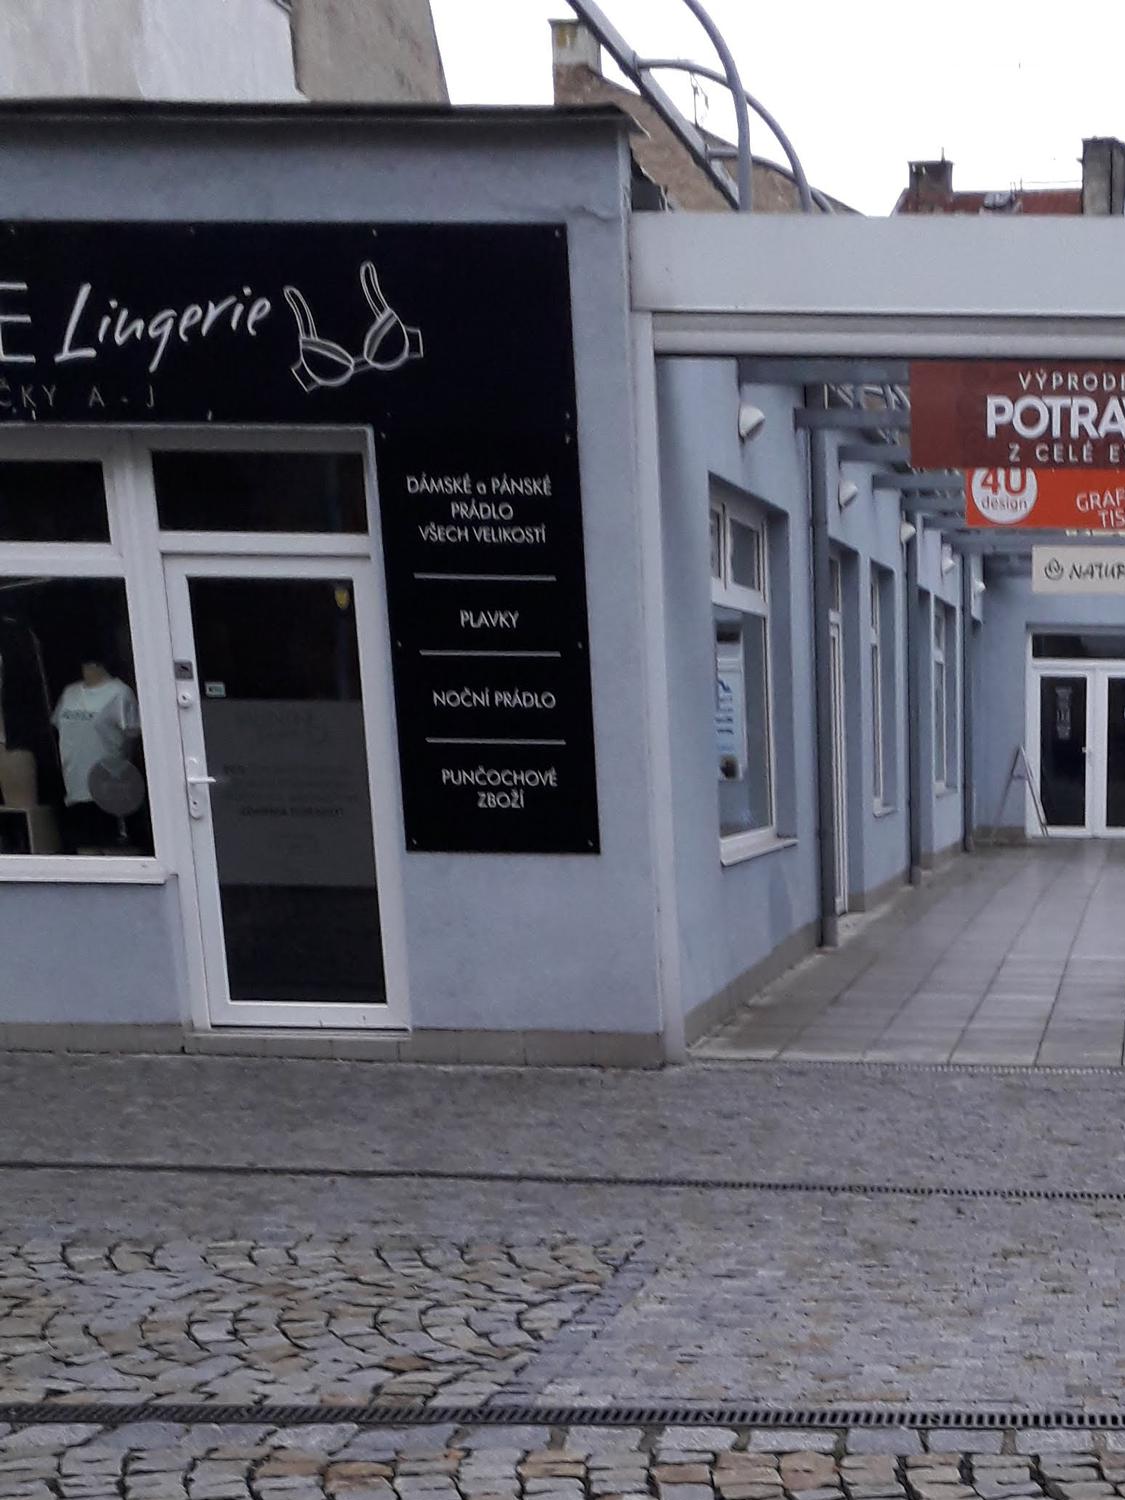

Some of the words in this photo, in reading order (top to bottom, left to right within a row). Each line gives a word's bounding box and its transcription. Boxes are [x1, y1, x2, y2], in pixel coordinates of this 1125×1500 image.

[54, 282, 271, 373] Lingerie
[1008, 444, 1020, 463] Z
[1035, 441, 1093, 464] CELÉ
[406, 472, 472, 495] DÁMSKÉ
[476, 481, 487, 495] a
[491, 472, 552, 496] PÁNSKÉ
[450, 498, 514, 520] PRÁDLO
[980, 497, 1027, 513] design
[418, 522, 469, 542] VŠECH
[472, 523, 546, 543] VELIKOSTÍ
[460, 610, 519, 629] PLAVKY
[432, 687, 490, 709] NOČNÍ
[494, 687, 557, 709] PRÁDLO
[441, 766, 558, 787] PUNČOCHOVÉ
[477, 790, 525, 809] ZBOŽÍ
